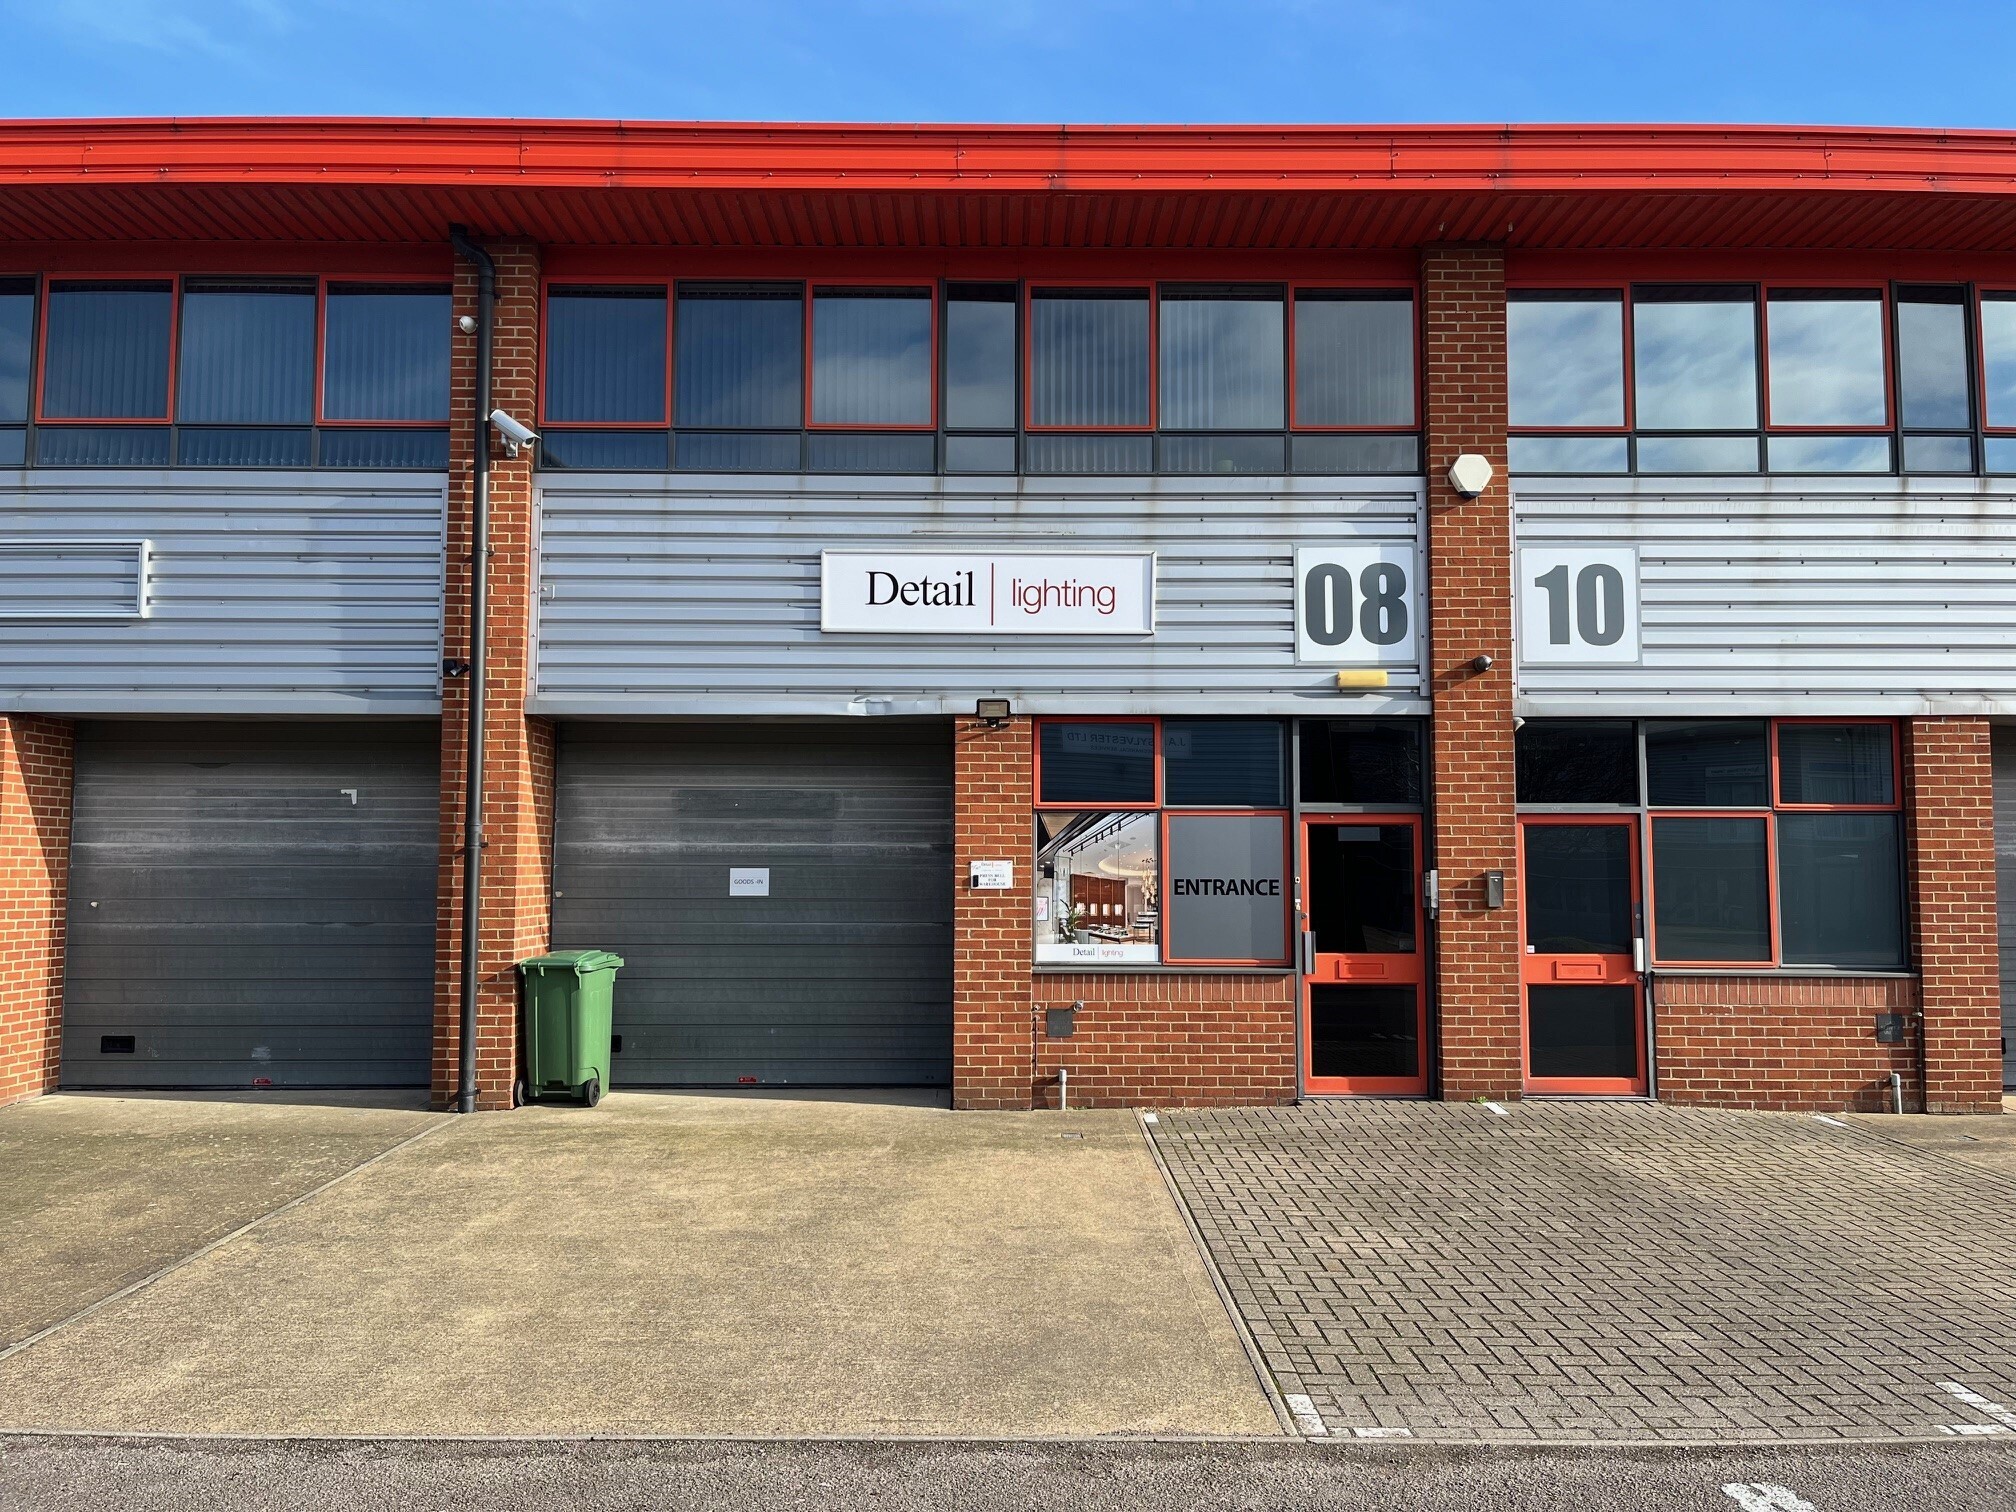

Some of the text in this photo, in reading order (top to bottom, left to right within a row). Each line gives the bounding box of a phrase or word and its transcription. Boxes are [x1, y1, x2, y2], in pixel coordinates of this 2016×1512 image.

[865, 570, 1116, 614] Detail lighting
[1304, 562, 1408, 646] 08
[1534, 563, 1625, 647] 10
[1174, 878, 1280, 896] ENTRANCE
[1072, 947, 1124, 958] Detail lighting
